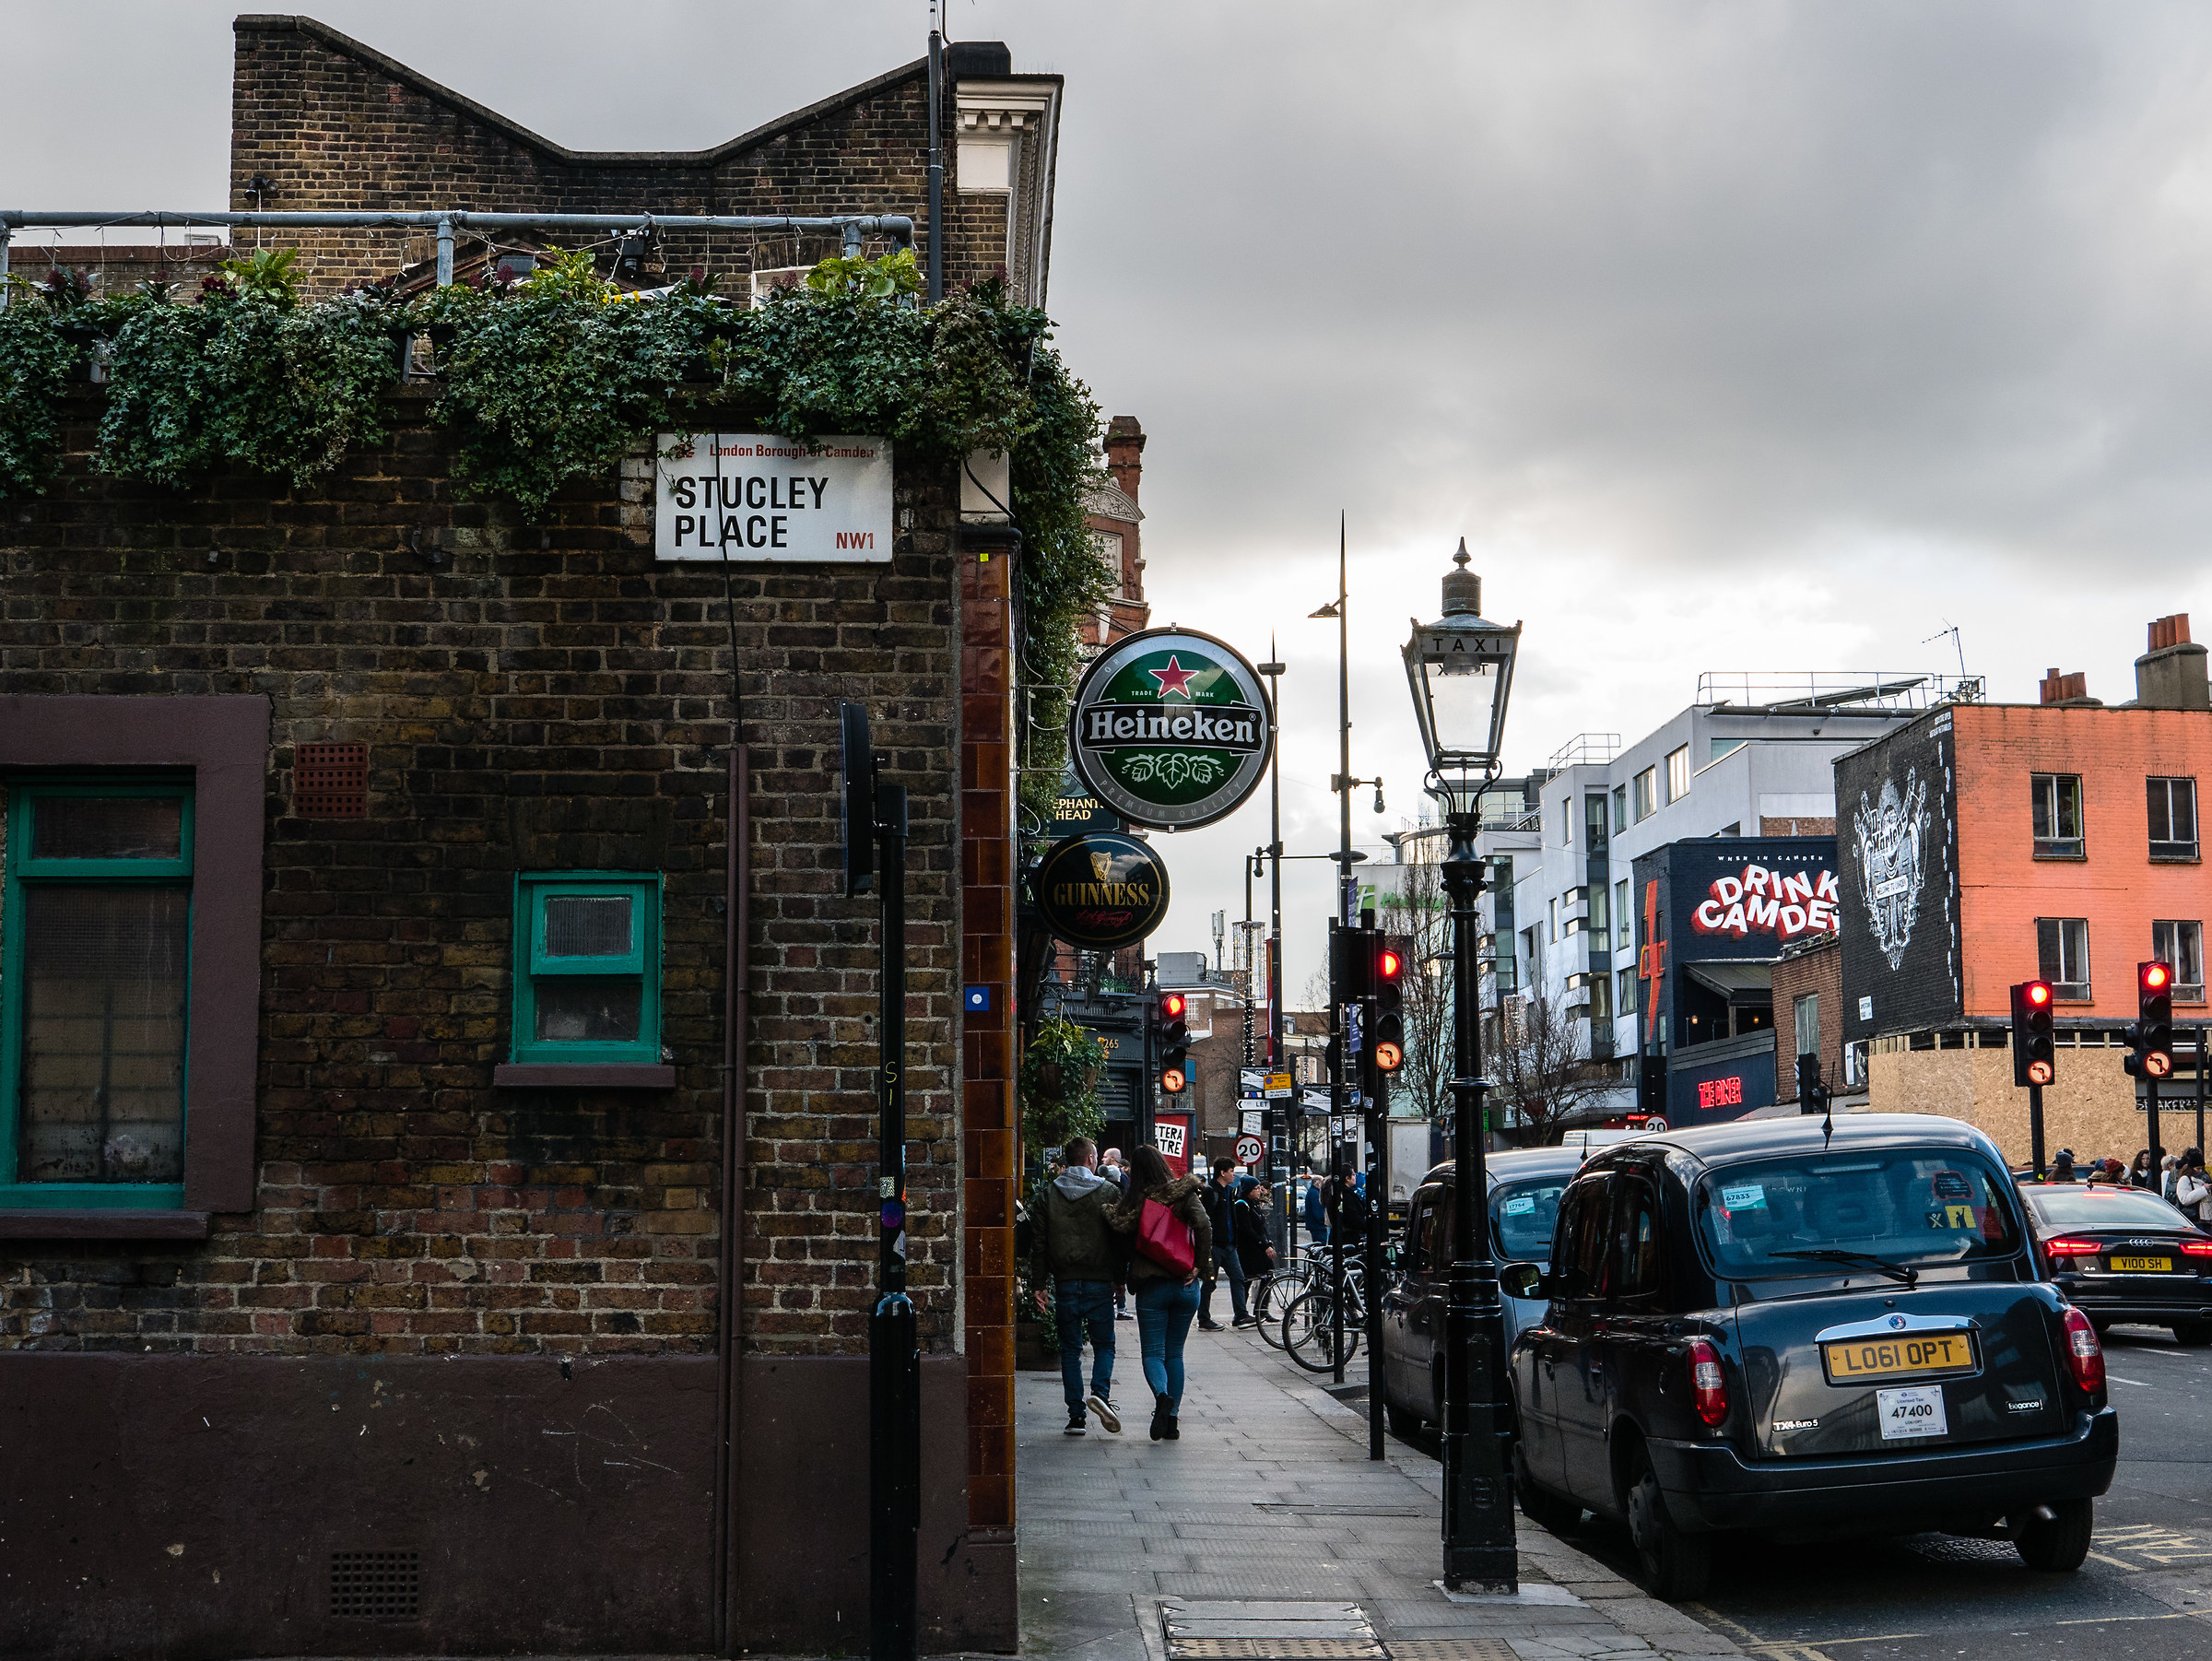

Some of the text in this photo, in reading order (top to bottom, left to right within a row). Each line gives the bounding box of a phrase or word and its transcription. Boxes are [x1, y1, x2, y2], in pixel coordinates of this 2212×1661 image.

[710, 443, 753, 457] London
[756, 443, 806, 460] Borough
[825, 445, 875, 459] Camden
[675, 477, 830, 510] STUCLEY
[675, 515, 788, 548] PLACE
[836, 532, 875, 549] NW1
[1432, 638, 1500, 653] TAXI
[1088, 709, 1255, 743] Heineken
[1100, 779, 1243, 819] PREMIUM QUALITY
[1055, 809, 1092, 820] HEAD
[1714, 864, 1840, 907] DRINK
[1053, 882, 1150, 907] GUINNESS
[1696, 894, 1841, 935] CAMDE
[1104, 1038, 1120, 1050] 265
[1698, 1076, 1742, 1109] THE DINER
[1238, 1142, 1261, 1158] 20
[1725, 1193, 1750, 1202] 67833
[2121, 1257, 2162, 1269] V100 SH
[1844, 1339, 1954, 1372] LO61 OPT
[1891, 1404, 1933, 1419] 47400
[2008, 1401, 2040, 1409] Elegance
[1772, 1420, 1795, 1431] TX4
[1813, 1419, 1818, 1427] 5
